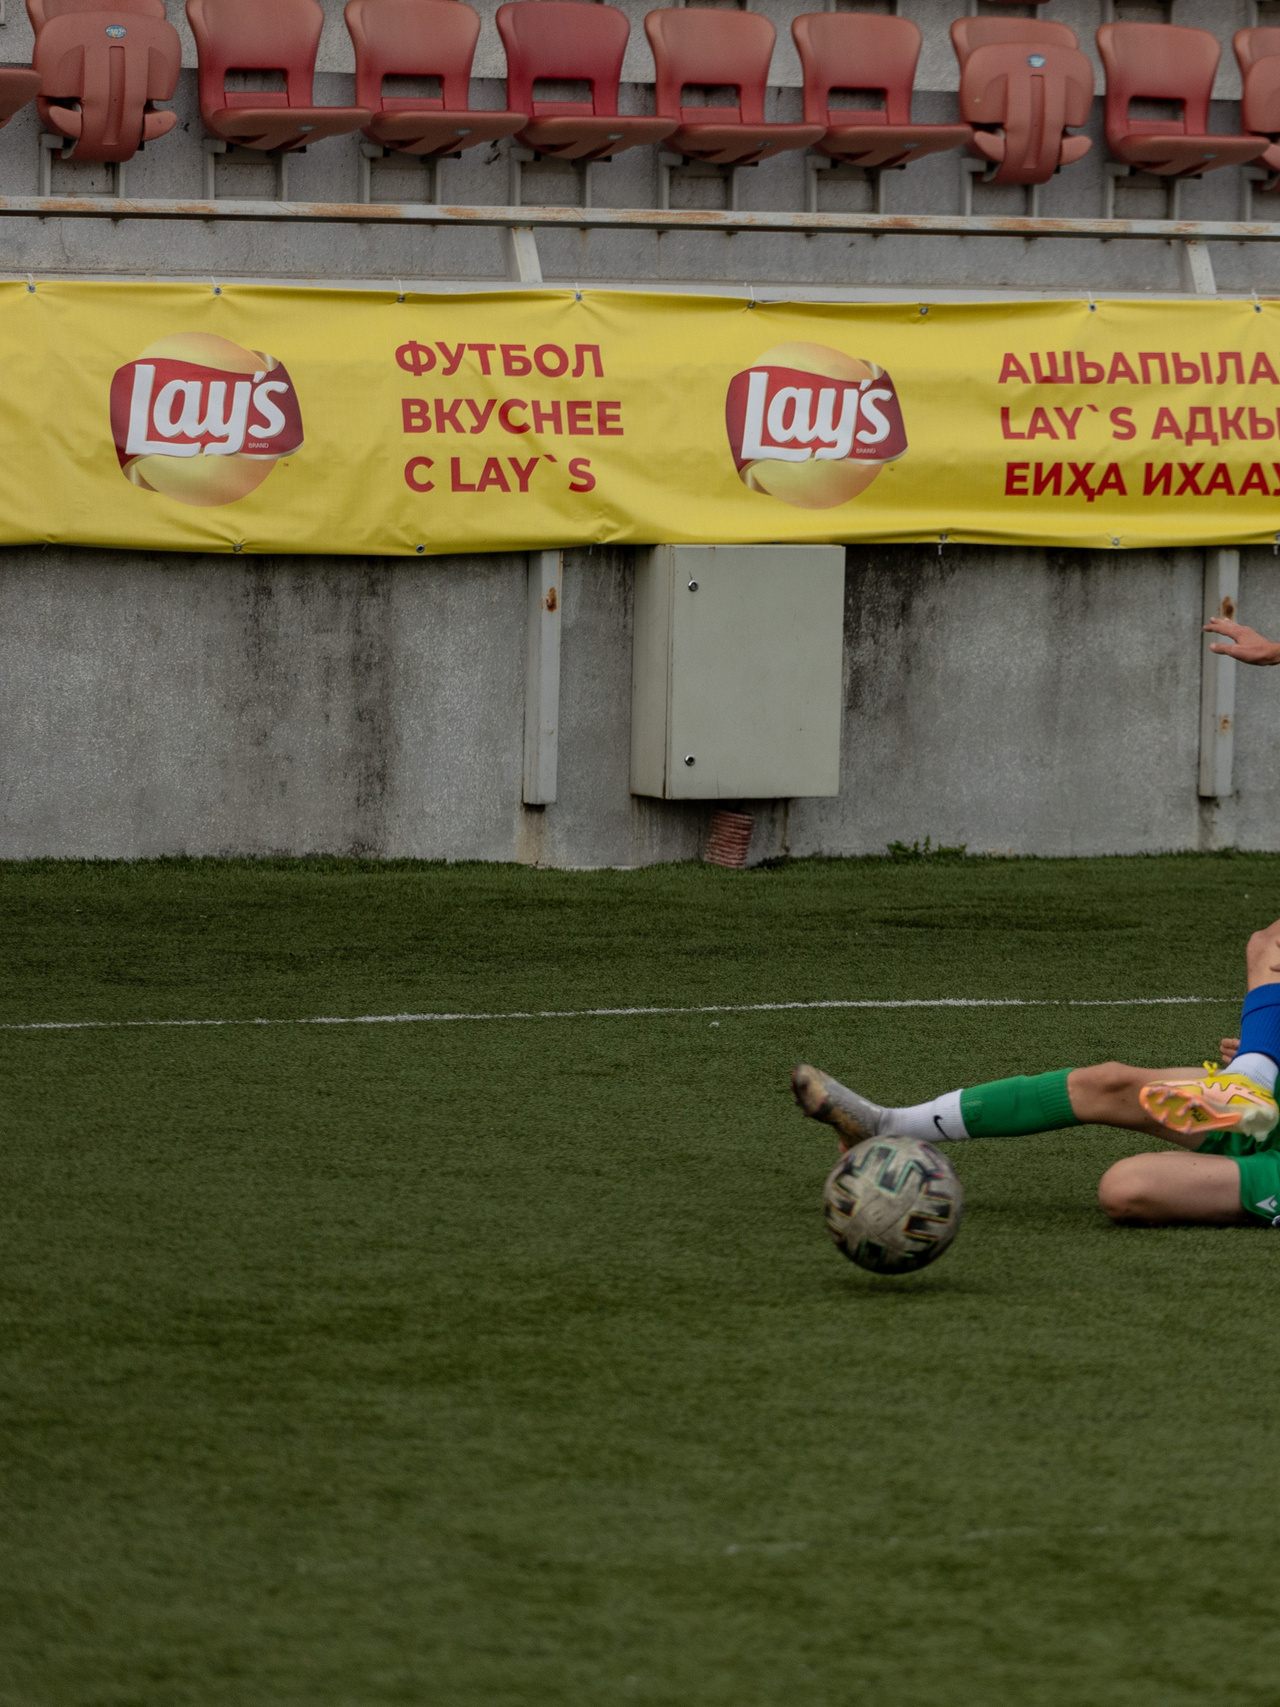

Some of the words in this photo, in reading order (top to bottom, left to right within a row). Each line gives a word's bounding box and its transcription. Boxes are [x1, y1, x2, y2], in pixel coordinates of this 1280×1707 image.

[395, 340, 604, 378] ФУТБОЛ
[125, 364, 289, 458] Lay's
[401, 398, 624, 436] ВКУСНЕЕ
[741, 372, 893, 462] Lay's
[404, 456, 435, 493] С
